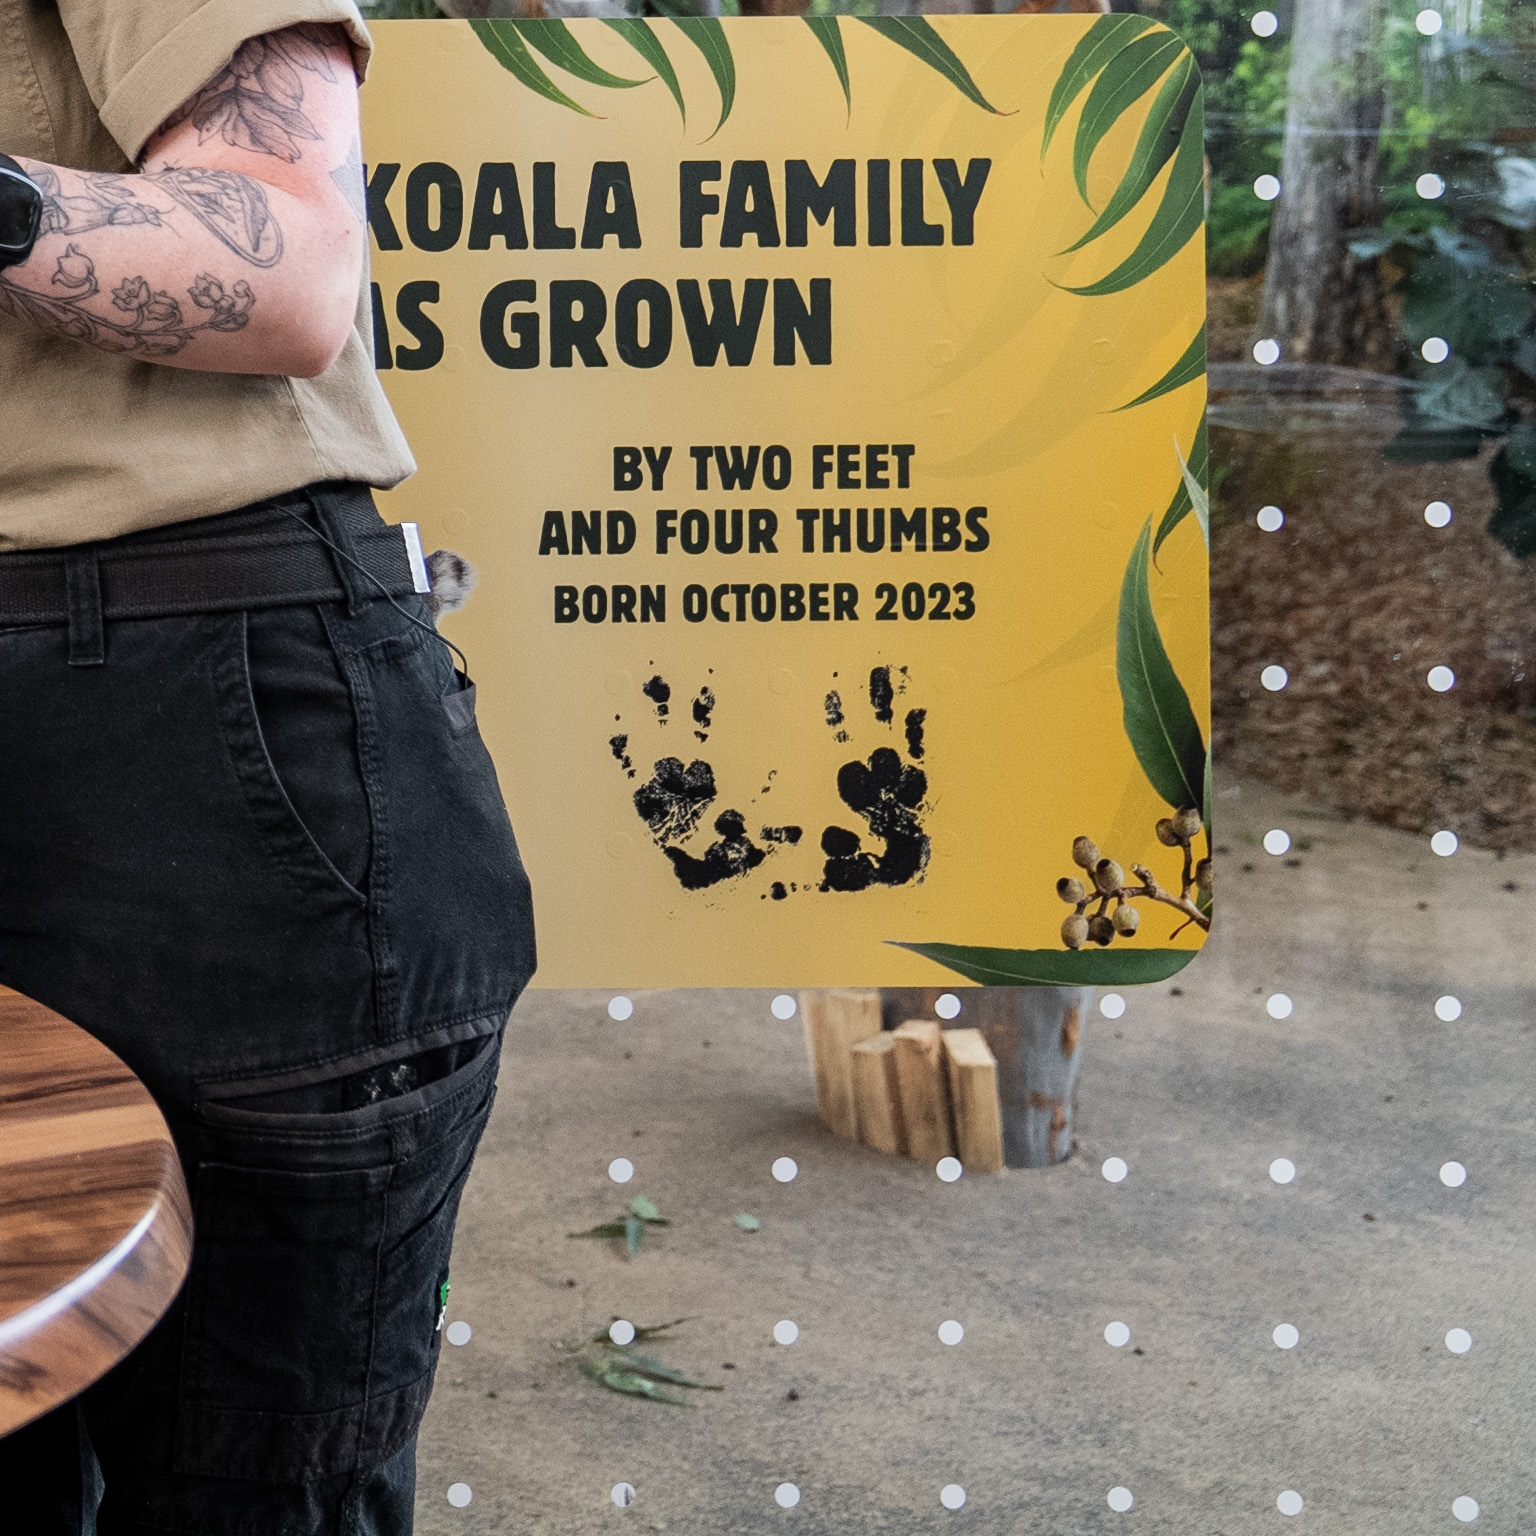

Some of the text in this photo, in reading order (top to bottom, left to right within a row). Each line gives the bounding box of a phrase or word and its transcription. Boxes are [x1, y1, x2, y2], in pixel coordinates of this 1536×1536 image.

[363, 157, 993, 253] KOALA FAMILY
[479, 277, 833, 370] GROWN
[613, 444, 916, 492] BY TWO FEET
[538, 506, 990, 556] AND FOUR THUMBS
[554, 581, 976, 624] BORN OCTOBER 2023
